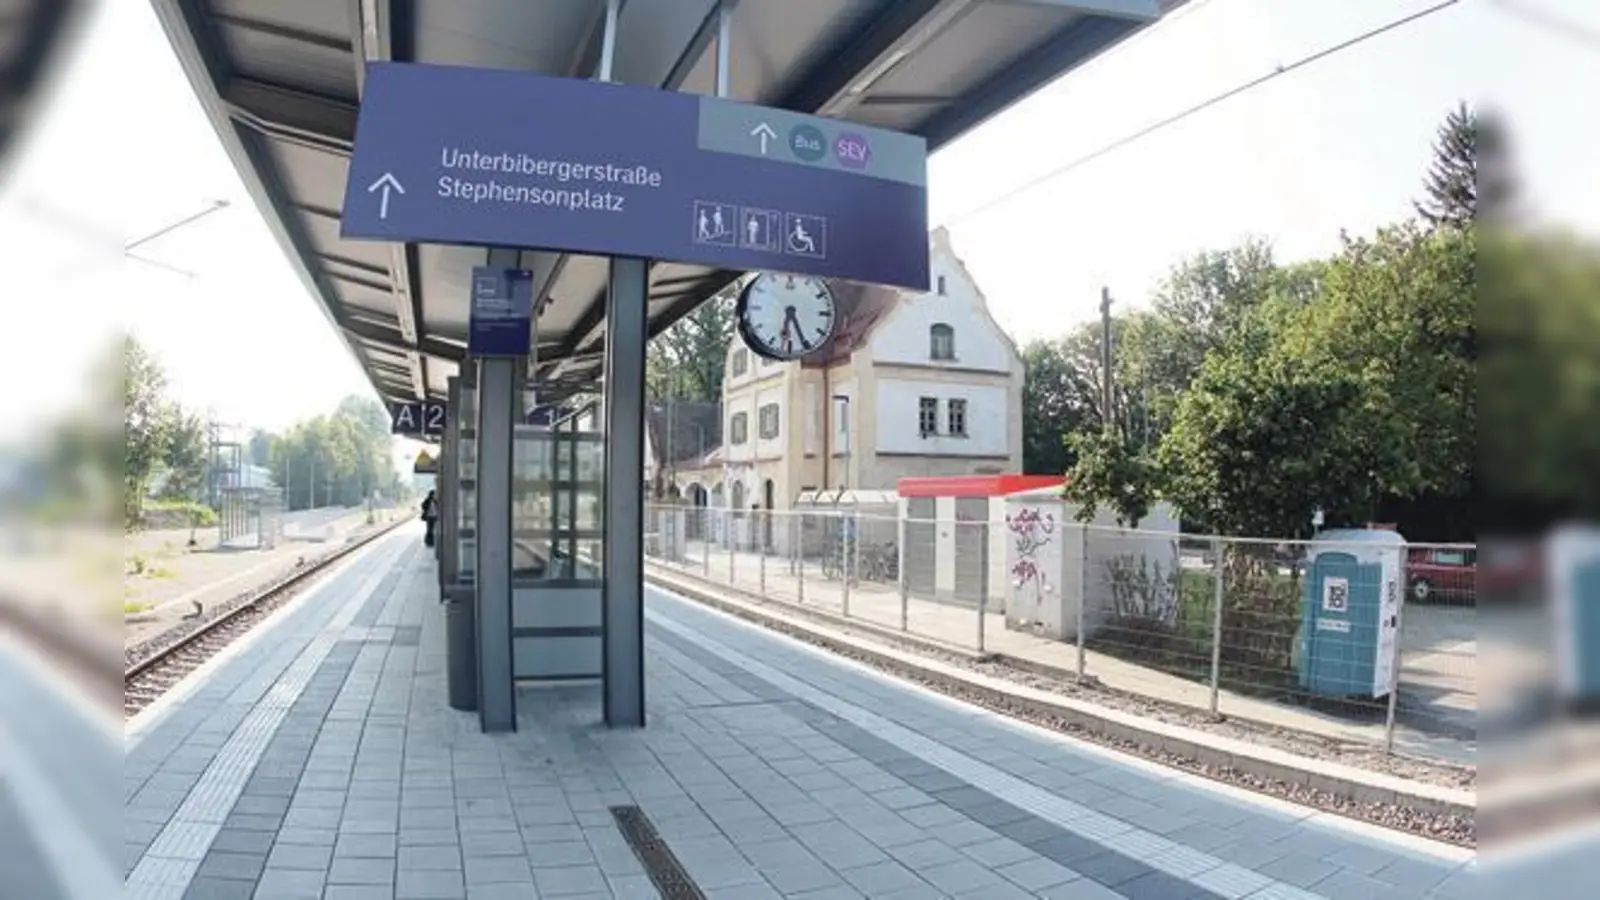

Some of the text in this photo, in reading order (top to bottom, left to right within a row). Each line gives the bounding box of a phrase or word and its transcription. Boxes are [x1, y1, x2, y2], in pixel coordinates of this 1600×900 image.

[795, 134, 820, 151] Bus
[838, 140, 866, 160] SEV
[442, 148, 662, 186] Unterbibergerstraße
[437, 177, 624, 211] Stephensonplatz
[396, 403, 415, 428] A
[428, 404, 445, 429] 2
